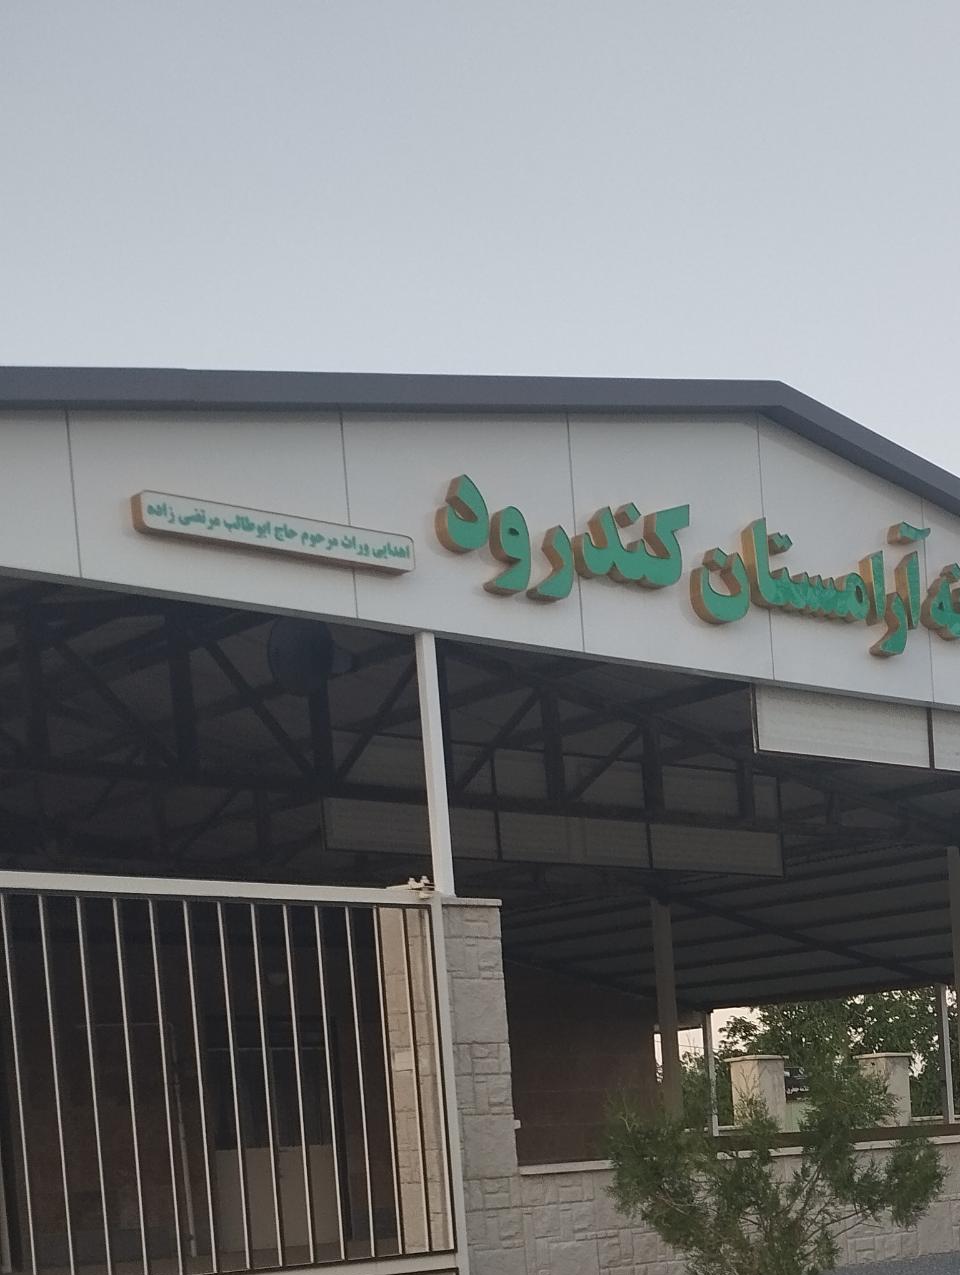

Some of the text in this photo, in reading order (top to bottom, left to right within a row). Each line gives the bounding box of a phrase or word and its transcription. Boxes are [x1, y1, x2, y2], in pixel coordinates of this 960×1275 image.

[223, 515, 271, 538] ابوطالب
[273, 523, 298, 542] حاج
[435, 474, 690, 602] کندرود
[300, 531, 339, 550] مرحوم
[690, 517, 931, 658] آرامستان
